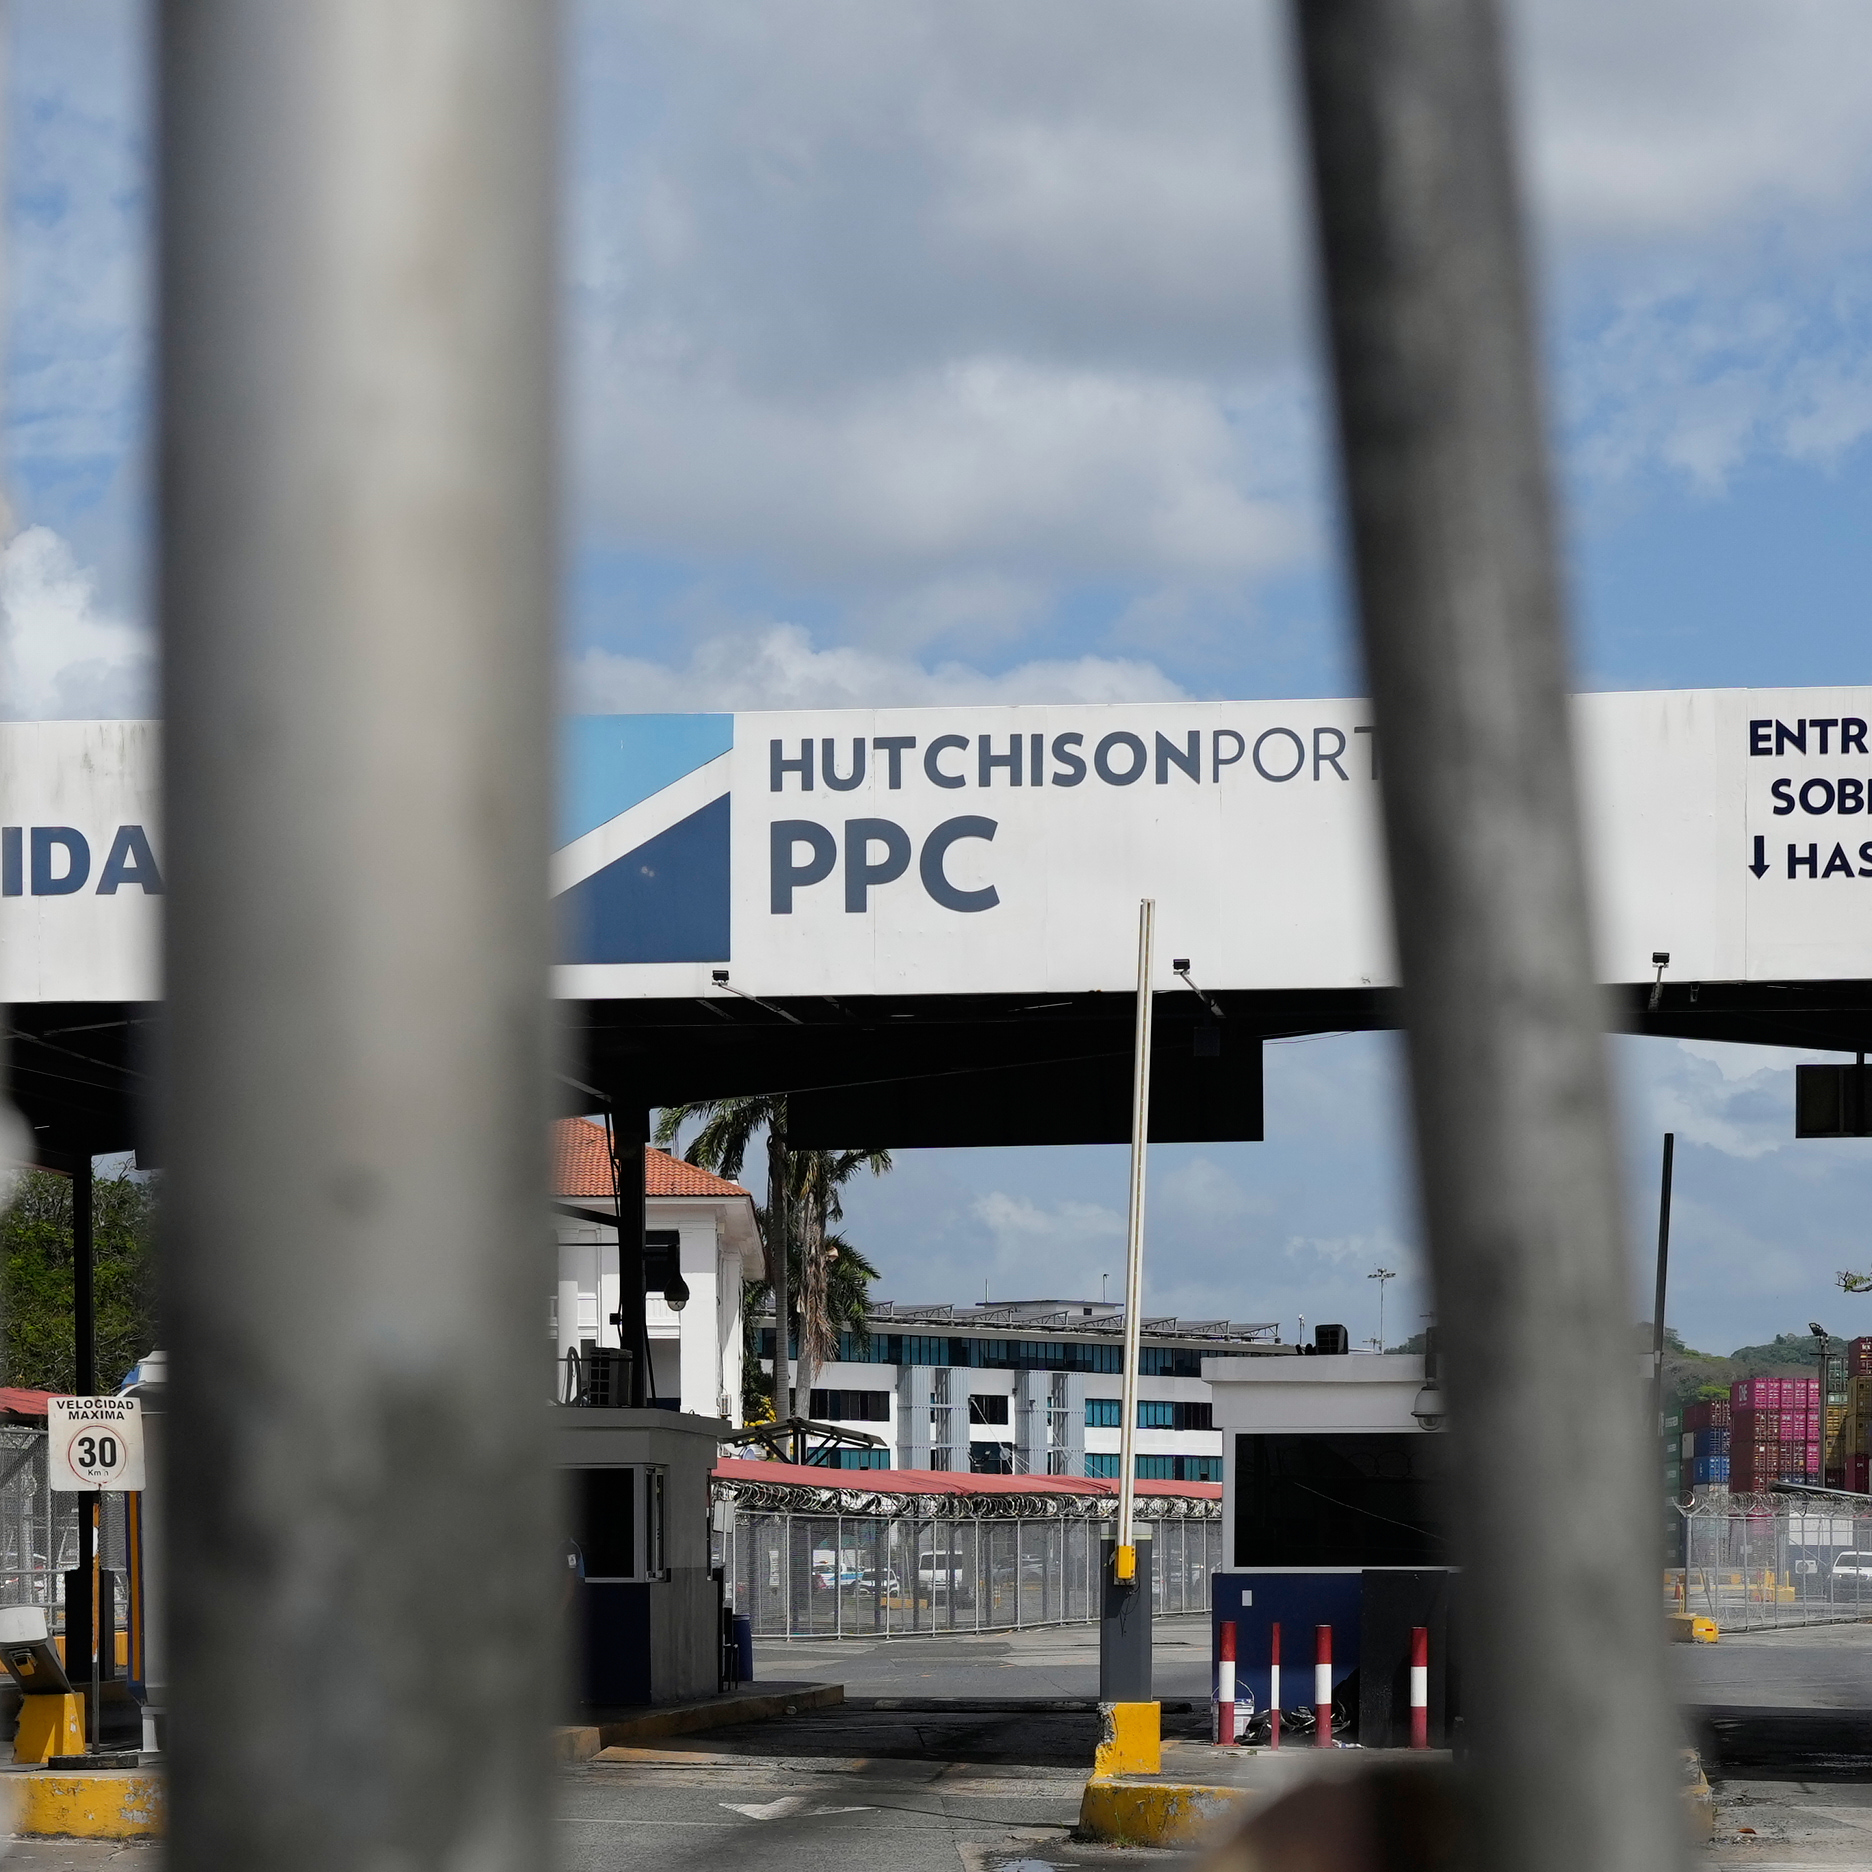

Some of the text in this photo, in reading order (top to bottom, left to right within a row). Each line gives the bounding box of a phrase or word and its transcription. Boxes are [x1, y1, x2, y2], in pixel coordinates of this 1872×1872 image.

[768, 814, 1001, 915] PPC
[56, 1399, 134, 1410] VELOCIDAD
[68, 1410, 125, 1421] MAXIMA
[78, 1437, 117, 1468] 30
